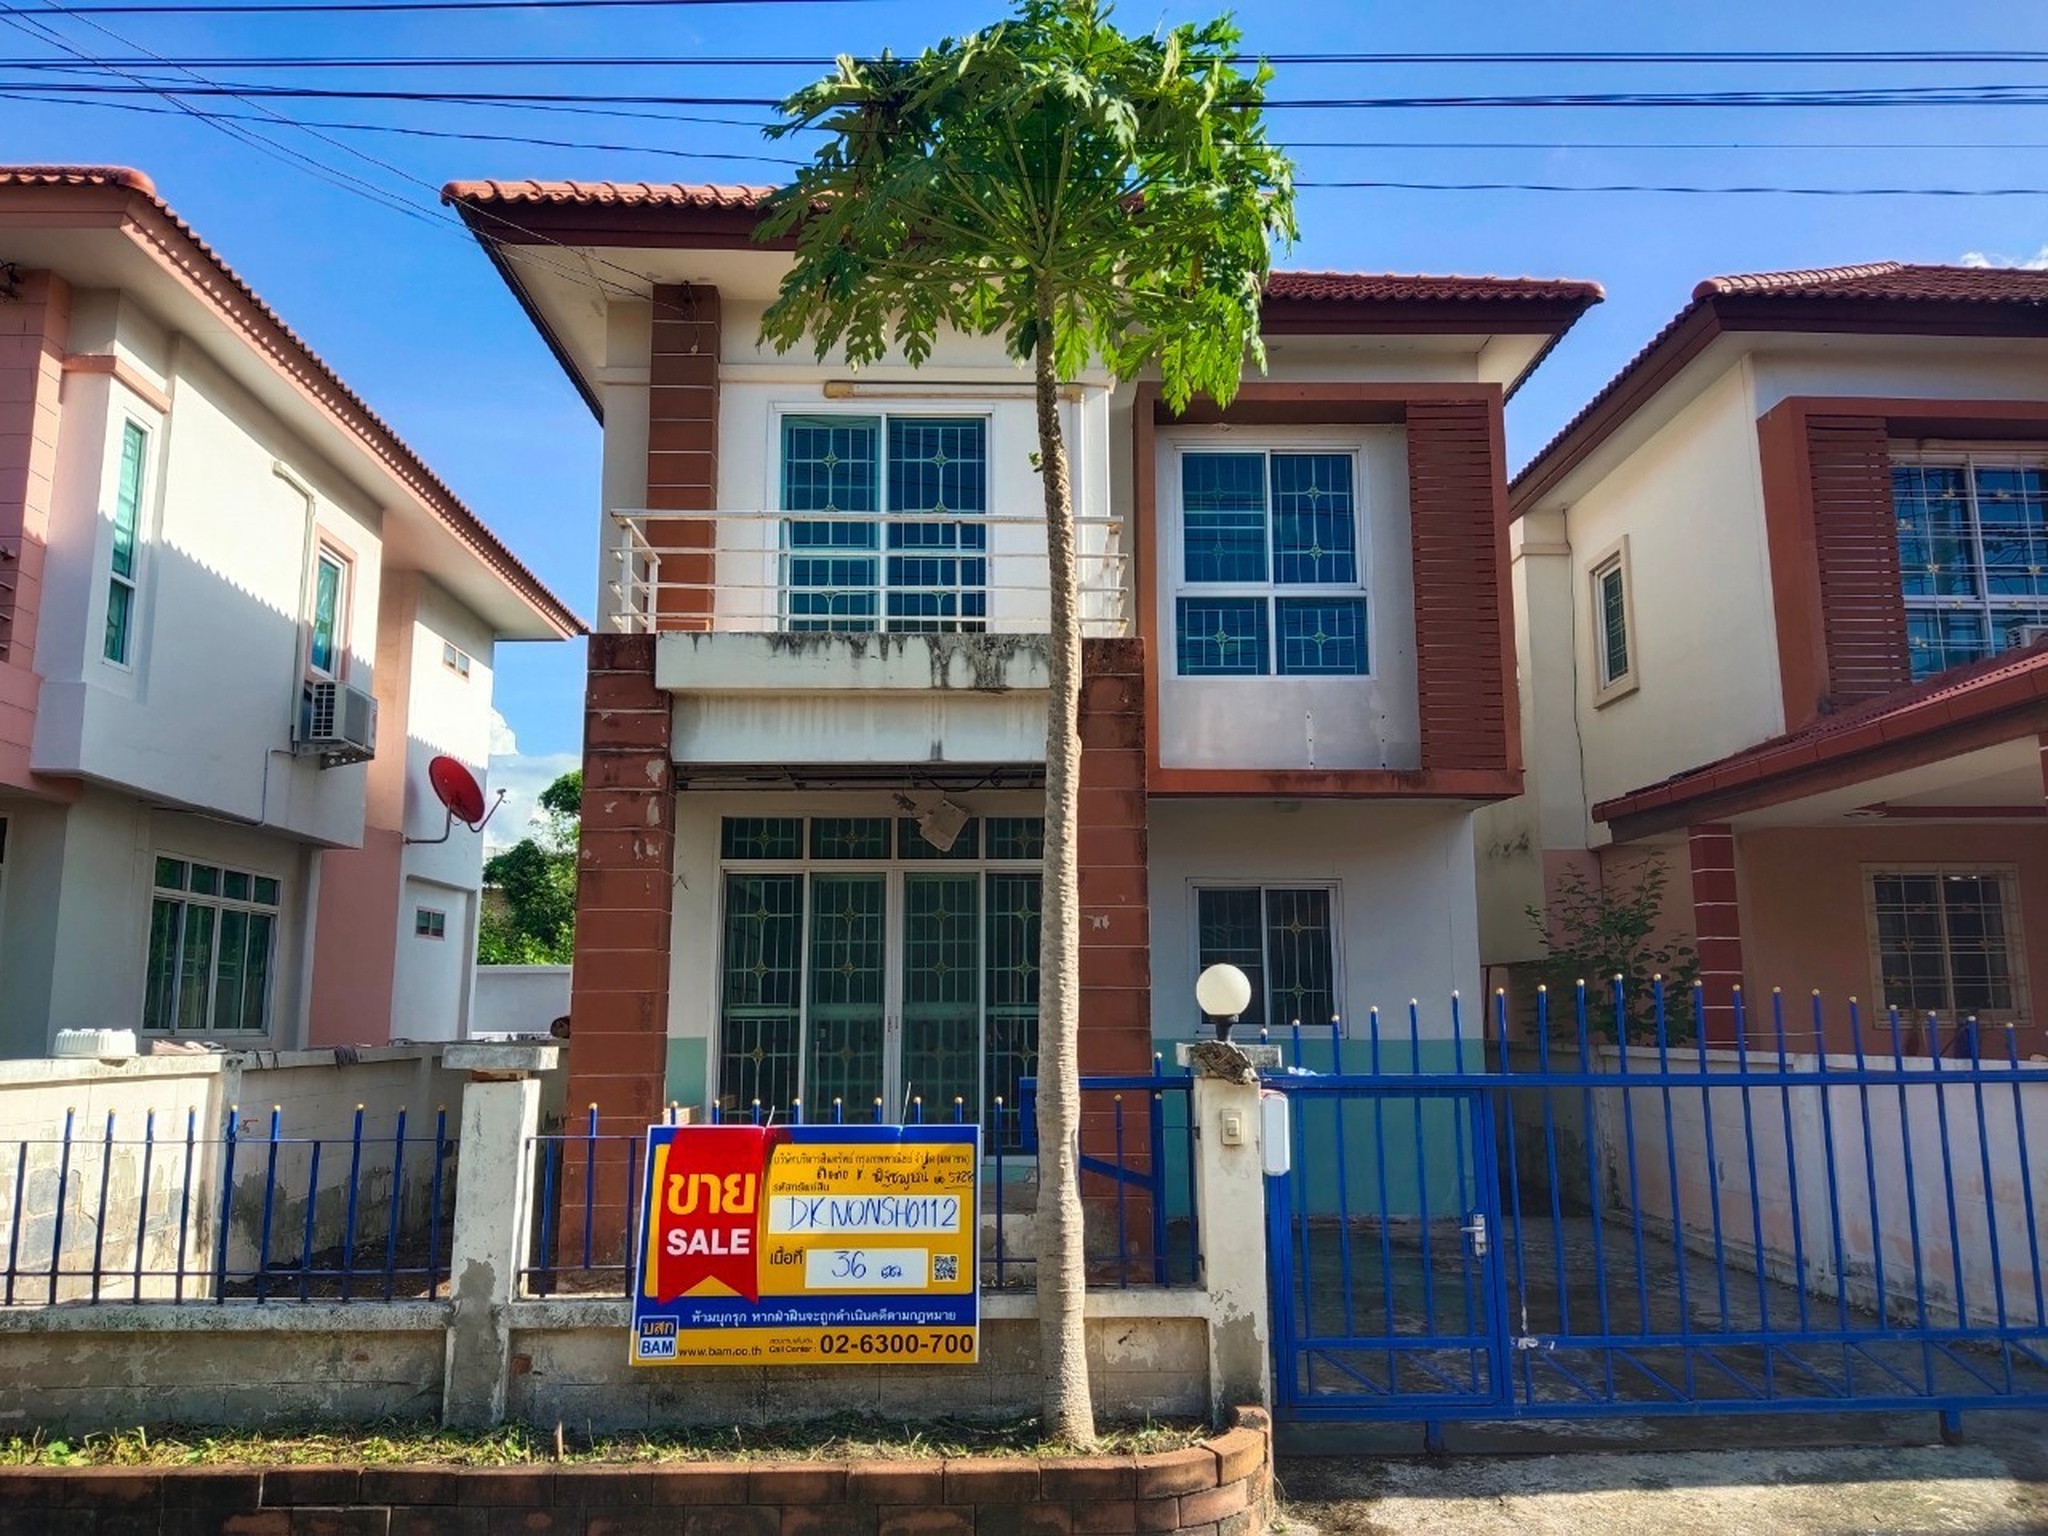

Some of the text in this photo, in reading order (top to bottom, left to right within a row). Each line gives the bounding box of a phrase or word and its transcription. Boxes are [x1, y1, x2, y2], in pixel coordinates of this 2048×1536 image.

[667, 1173, 756, 1215] ขาย
[666, 1228, 751, 1255] SALE
[831, 1250, 866, 1279] 36
[692, 1310, 746, 1327] ห้ามบุกรุก
[643, 1321, 673, 1335] บสก
[641, 1340, 673, 1355] BAM
[678, 1346, 762, 1357] www.bam.co.th
[769, 1345, 784, 1353] Call
[820, 1334, 974, 1354] 02-6300-700
